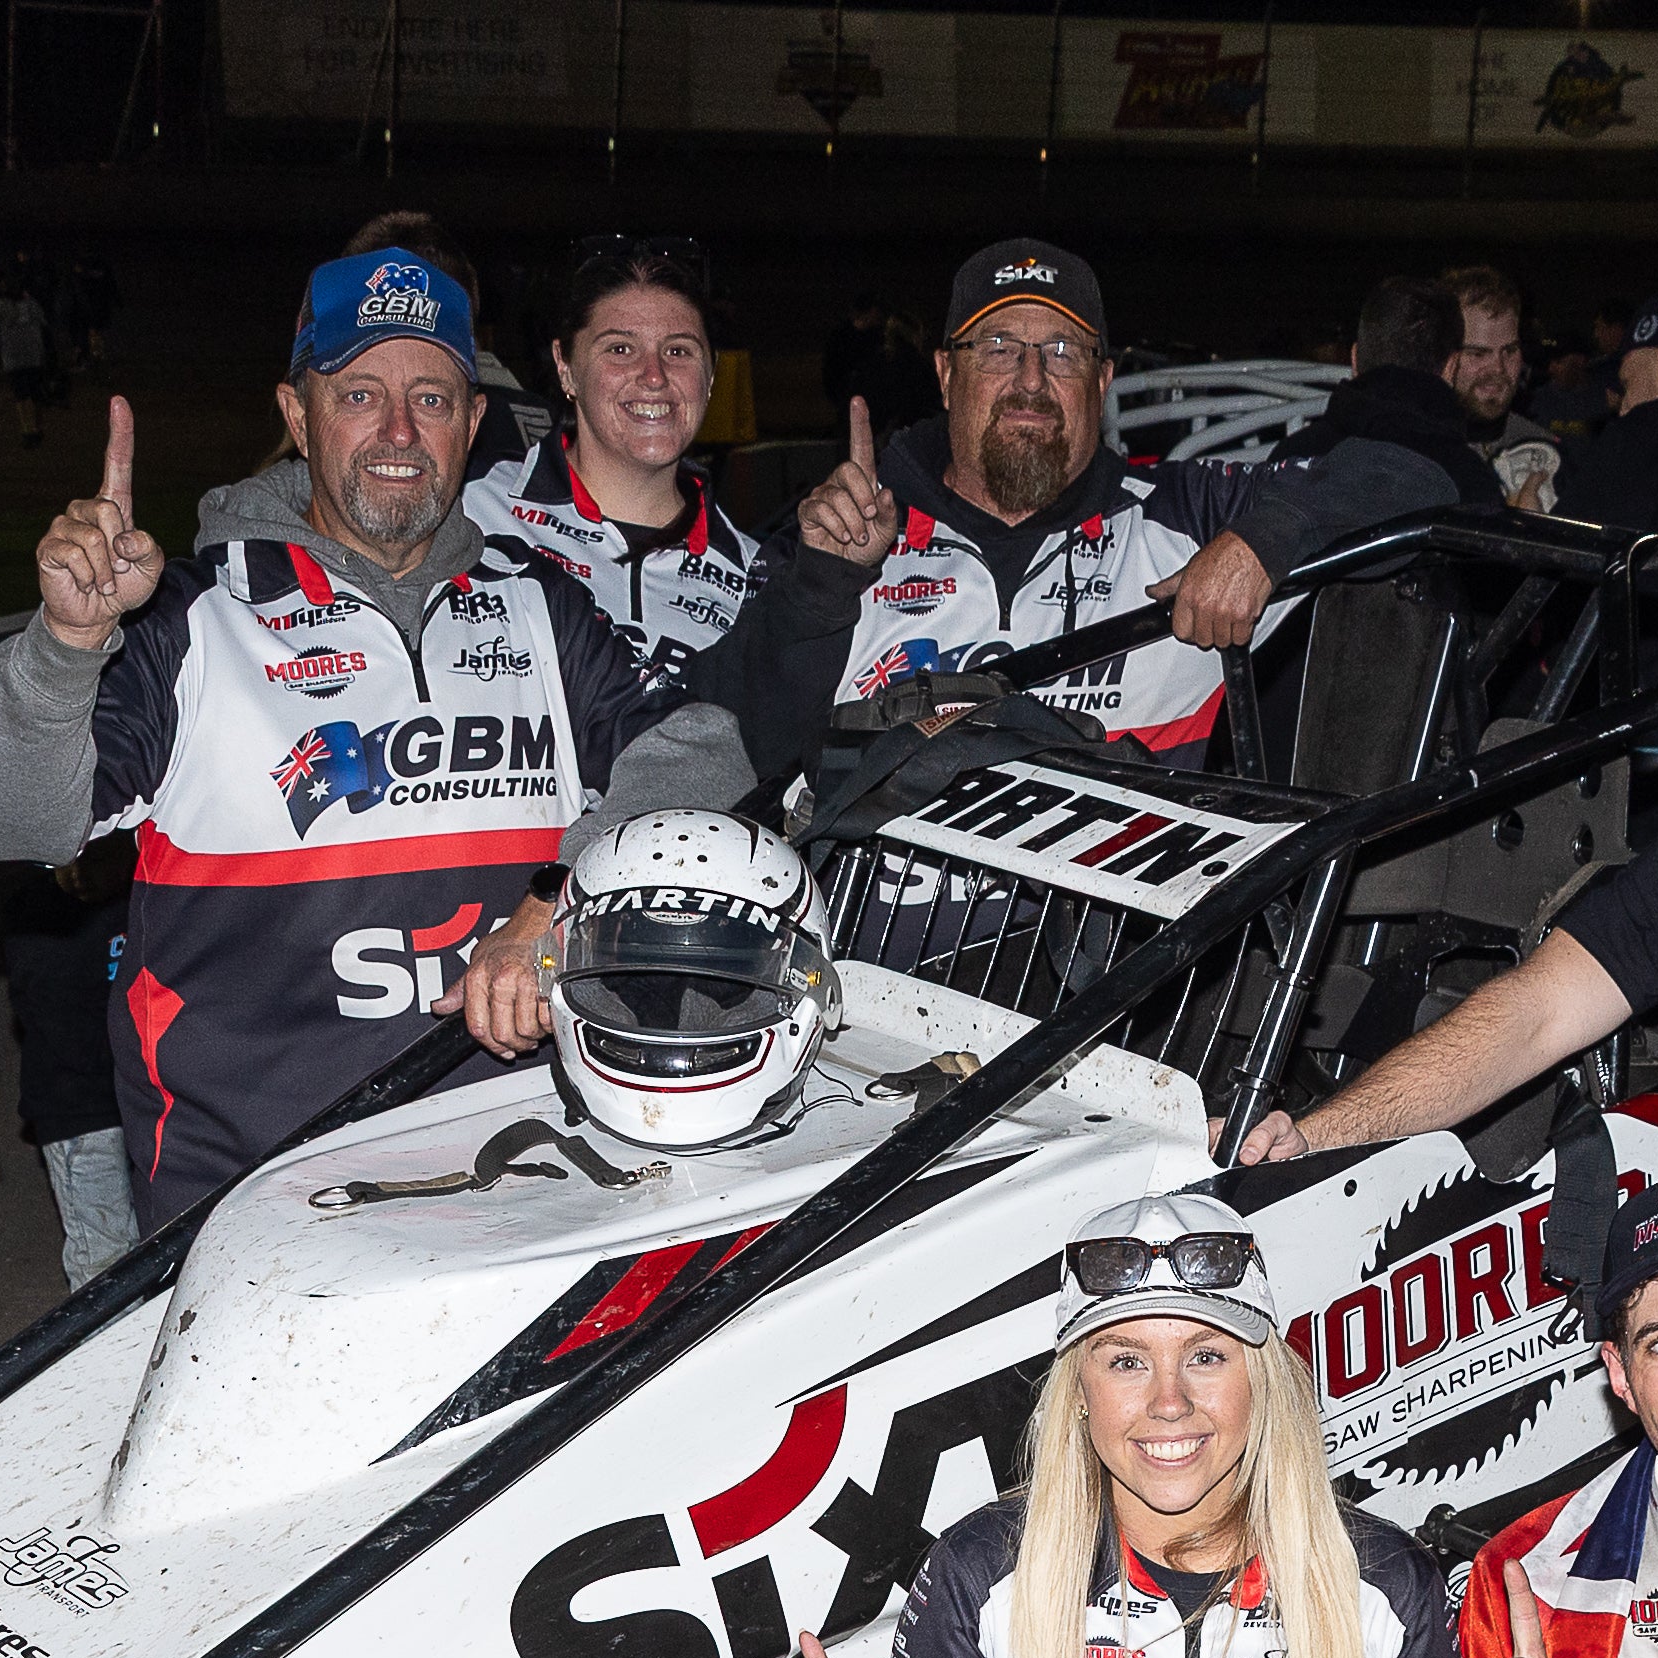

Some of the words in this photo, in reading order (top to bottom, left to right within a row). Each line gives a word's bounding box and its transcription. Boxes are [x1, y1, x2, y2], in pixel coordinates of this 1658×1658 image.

[356, 314, 435, 331] CONSULTING
[360, 294, 441, 321] GBM
[872, 575, 958, 603] MOORES
[264, 650, 368, 683] MOORES
[389, 714, 555, 778] GBM
[389, 776, 558, 807] CONSULTING
[904, 768, 1248, 886] ARTIN
[577, 887, 782, 933] MARTIN
[1324, 1410, 1381, 1455] SAW
[33, 1581, 91, 1619] TRANSPORT
